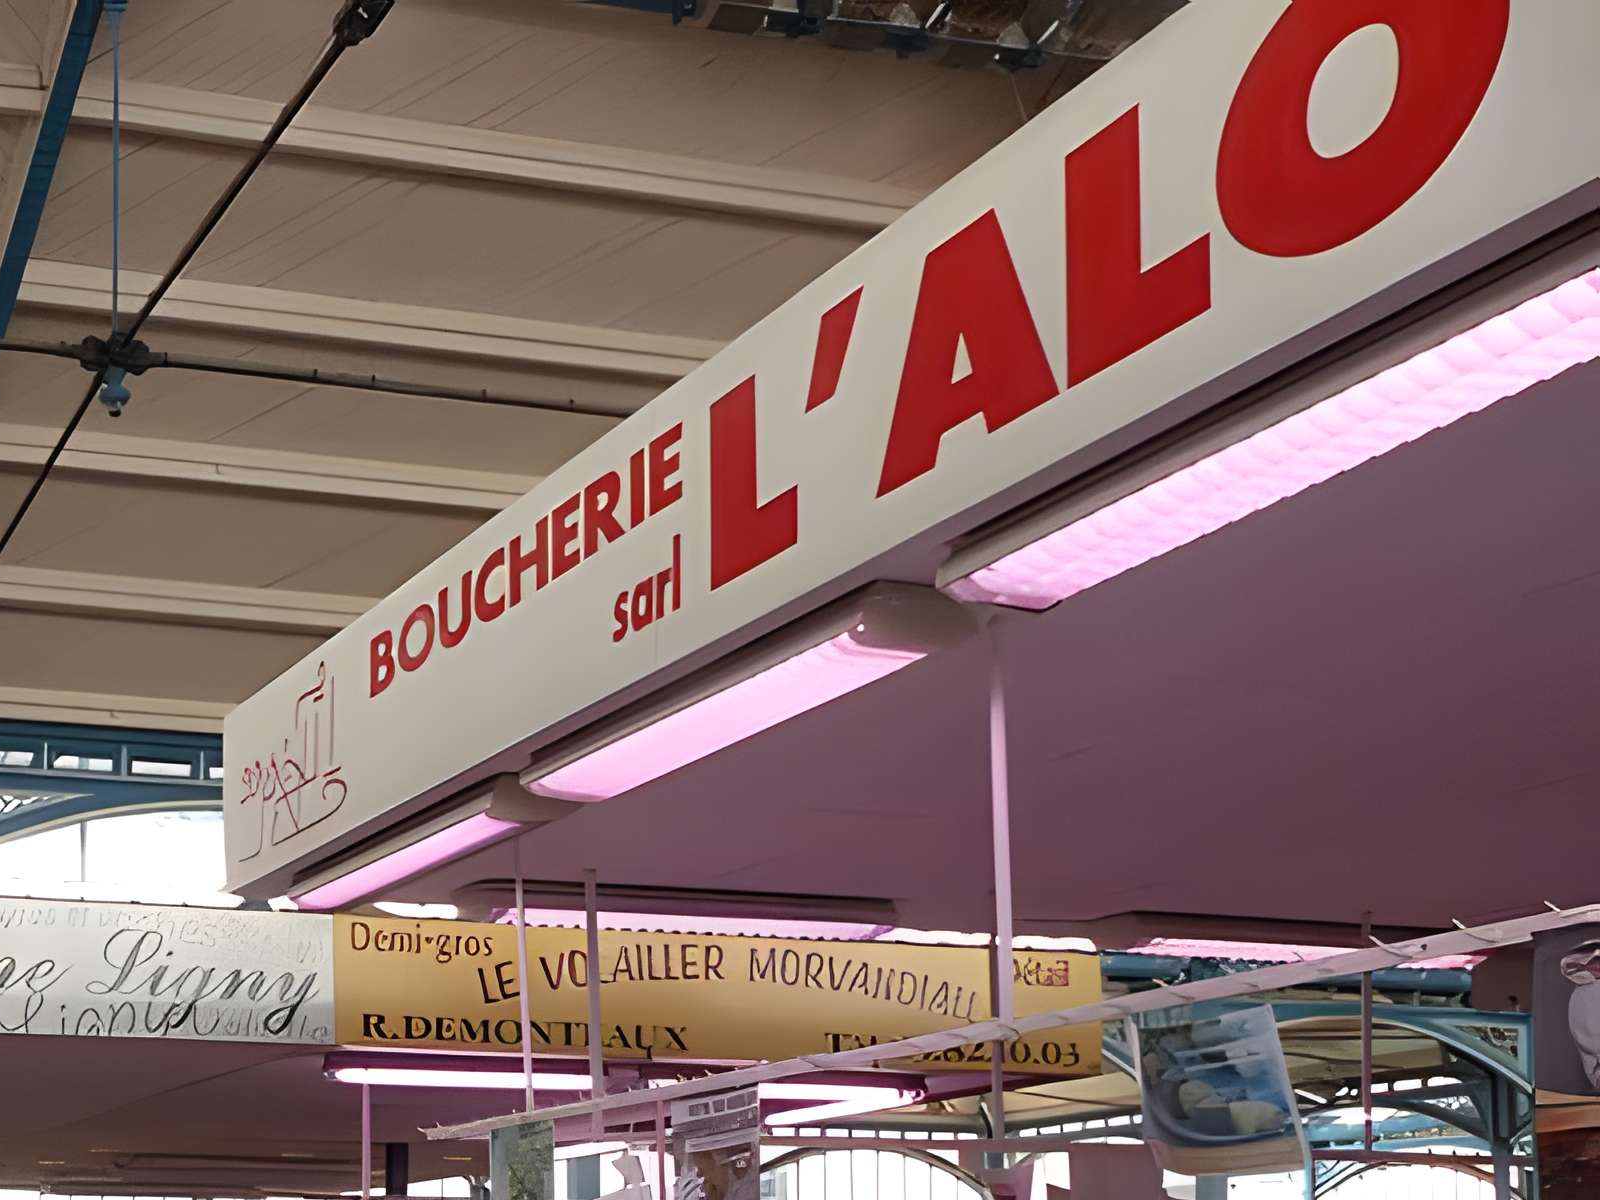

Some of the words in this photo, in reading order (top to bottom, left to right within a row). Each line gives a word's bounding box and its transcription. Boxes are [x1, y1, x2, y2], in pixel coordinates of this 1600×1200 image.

[369, 421, 684, 699] BOUCHERIE
[612, 533, 682, 643] sarl
[86, 928, 320, 1036] Ligny
[477, 961, 520, 1004] LE
